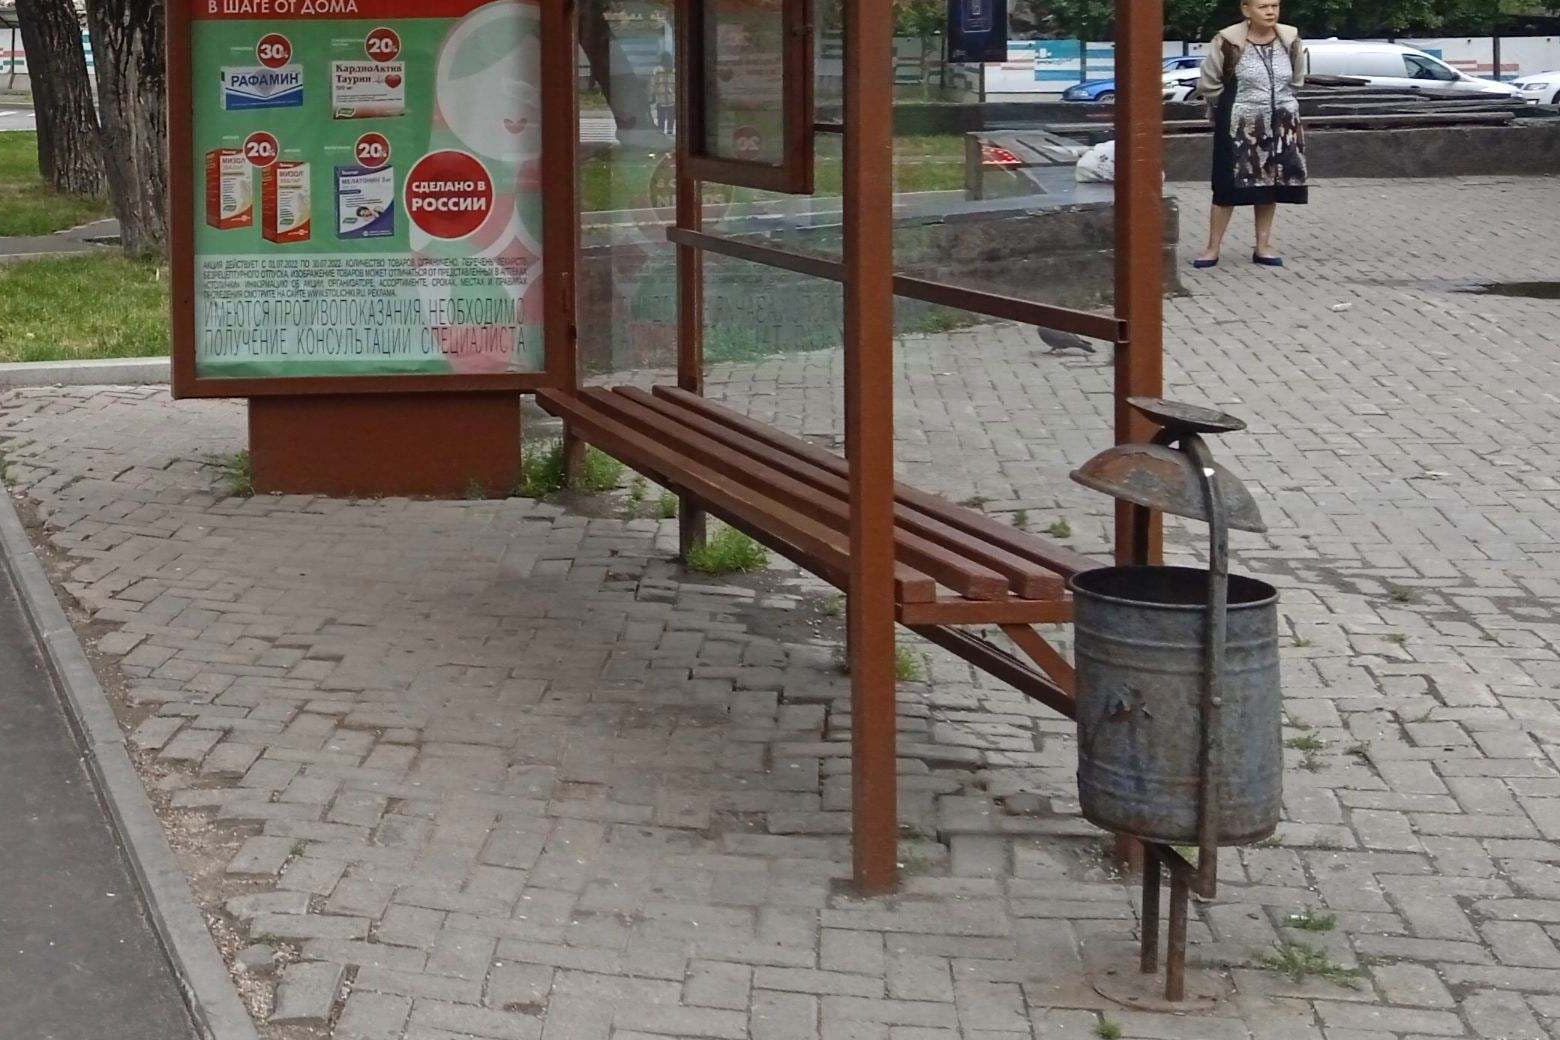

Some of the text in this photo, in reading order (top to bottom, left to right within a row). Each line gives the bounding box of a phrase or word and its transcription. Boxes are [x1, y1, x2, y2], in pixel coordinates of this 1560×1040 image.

[208, 0, 359, 15] В ШАГЕ ОТ ДОМА
[336, 64, 402, 74] КардиоАктив
[231, 73, 300, 87] РАФАМИН
[336, 75, 371, 85] Таурин
[412, 181, 486, 194] СДЕЛАНО В
[412, 197, 486, 211] РОССИИ
[205, 297, 525, 327] ИМЕЮТСЯ ПРОТИВОПОКАЗАНИЯ. НЕОБХОДИМО
[205, 326, 527, 356] ПОЛУЧЕНИЕ КОНСУЛЬТАЦИИ СПЕЦИАЛИСТА
